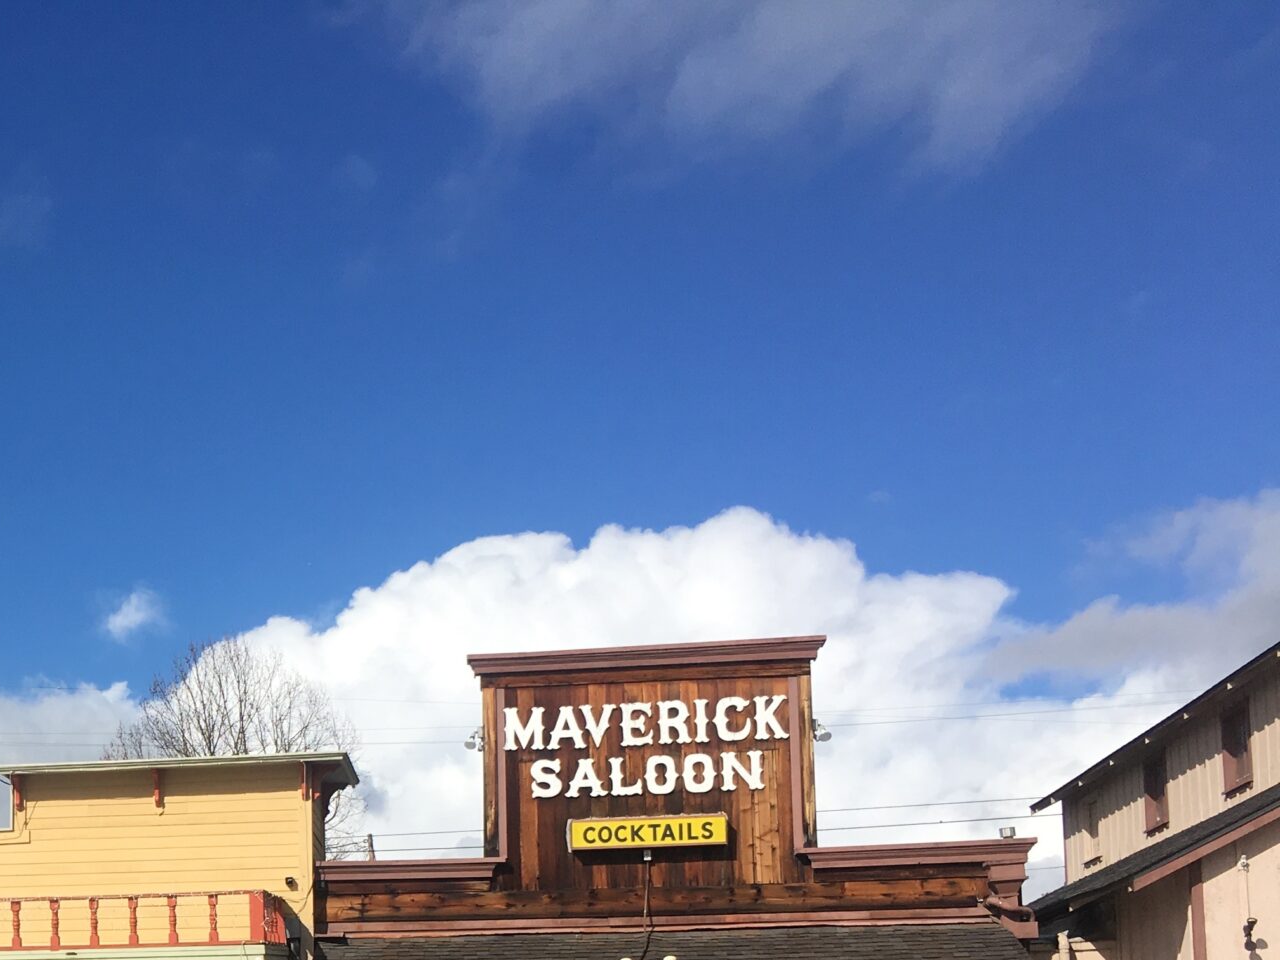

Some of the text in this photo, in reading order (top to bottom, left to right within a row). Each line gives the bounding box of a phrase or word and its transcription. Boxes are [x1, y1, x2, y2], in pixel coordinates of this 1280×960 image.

[503, 694, 790, 751] MAVERICK
[531, 750, 766, 799] SALOON
[583, 821, 714, 844] COCKTAILS
